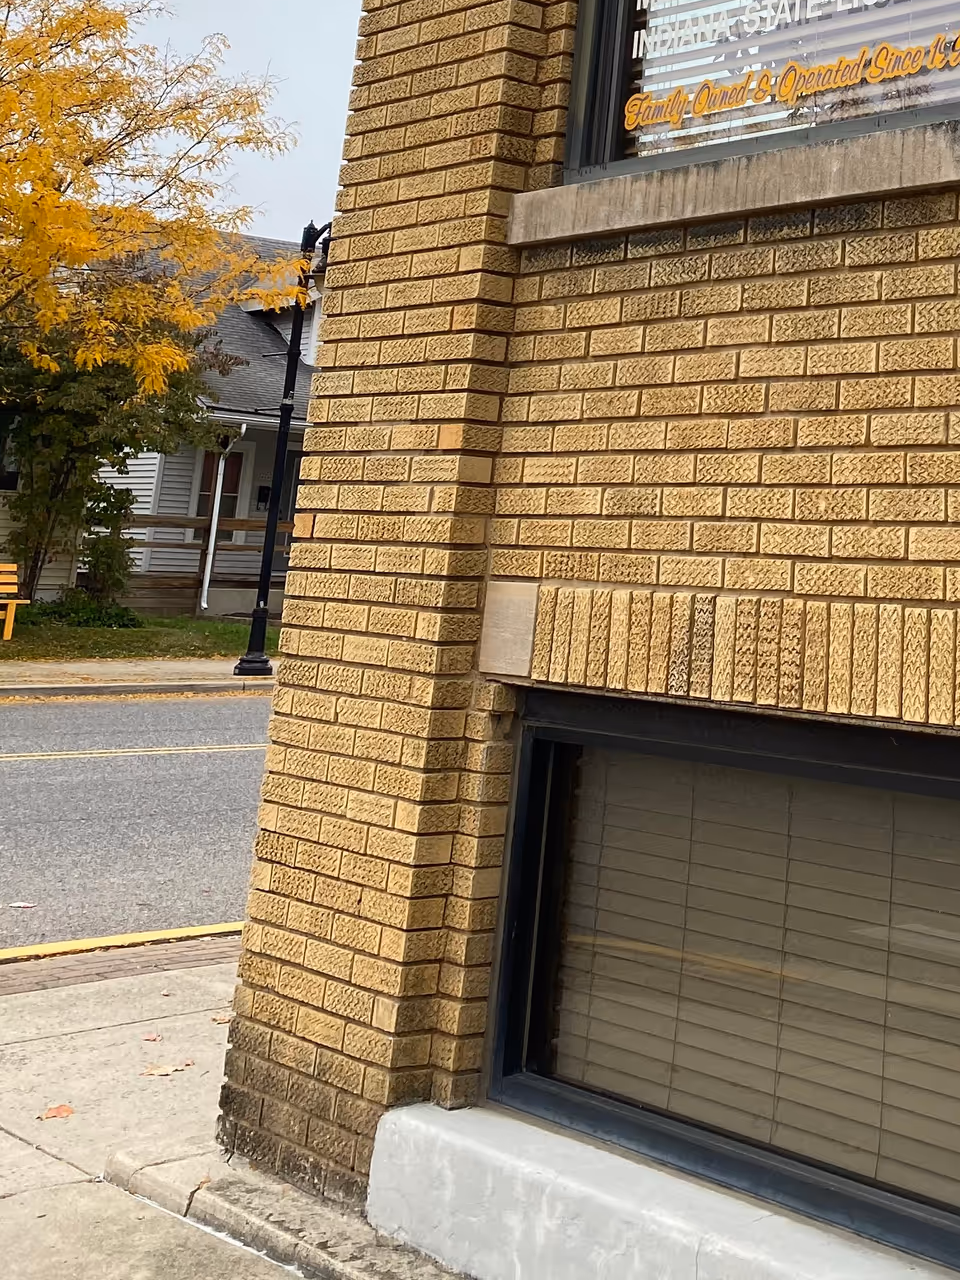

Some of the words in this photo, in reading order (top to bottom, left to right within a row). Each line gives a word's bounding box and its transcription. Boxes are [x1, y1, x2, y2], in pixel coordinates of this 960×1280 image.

[632, 10, 731, 59] INDIANA
[624, 85, 689, 131] Family
[691, 71, 753, 117] Owned
[753, 71, 771, 102] &
[775, 46, 870, 105] Operated
[868, 41, 924, 83] Since
